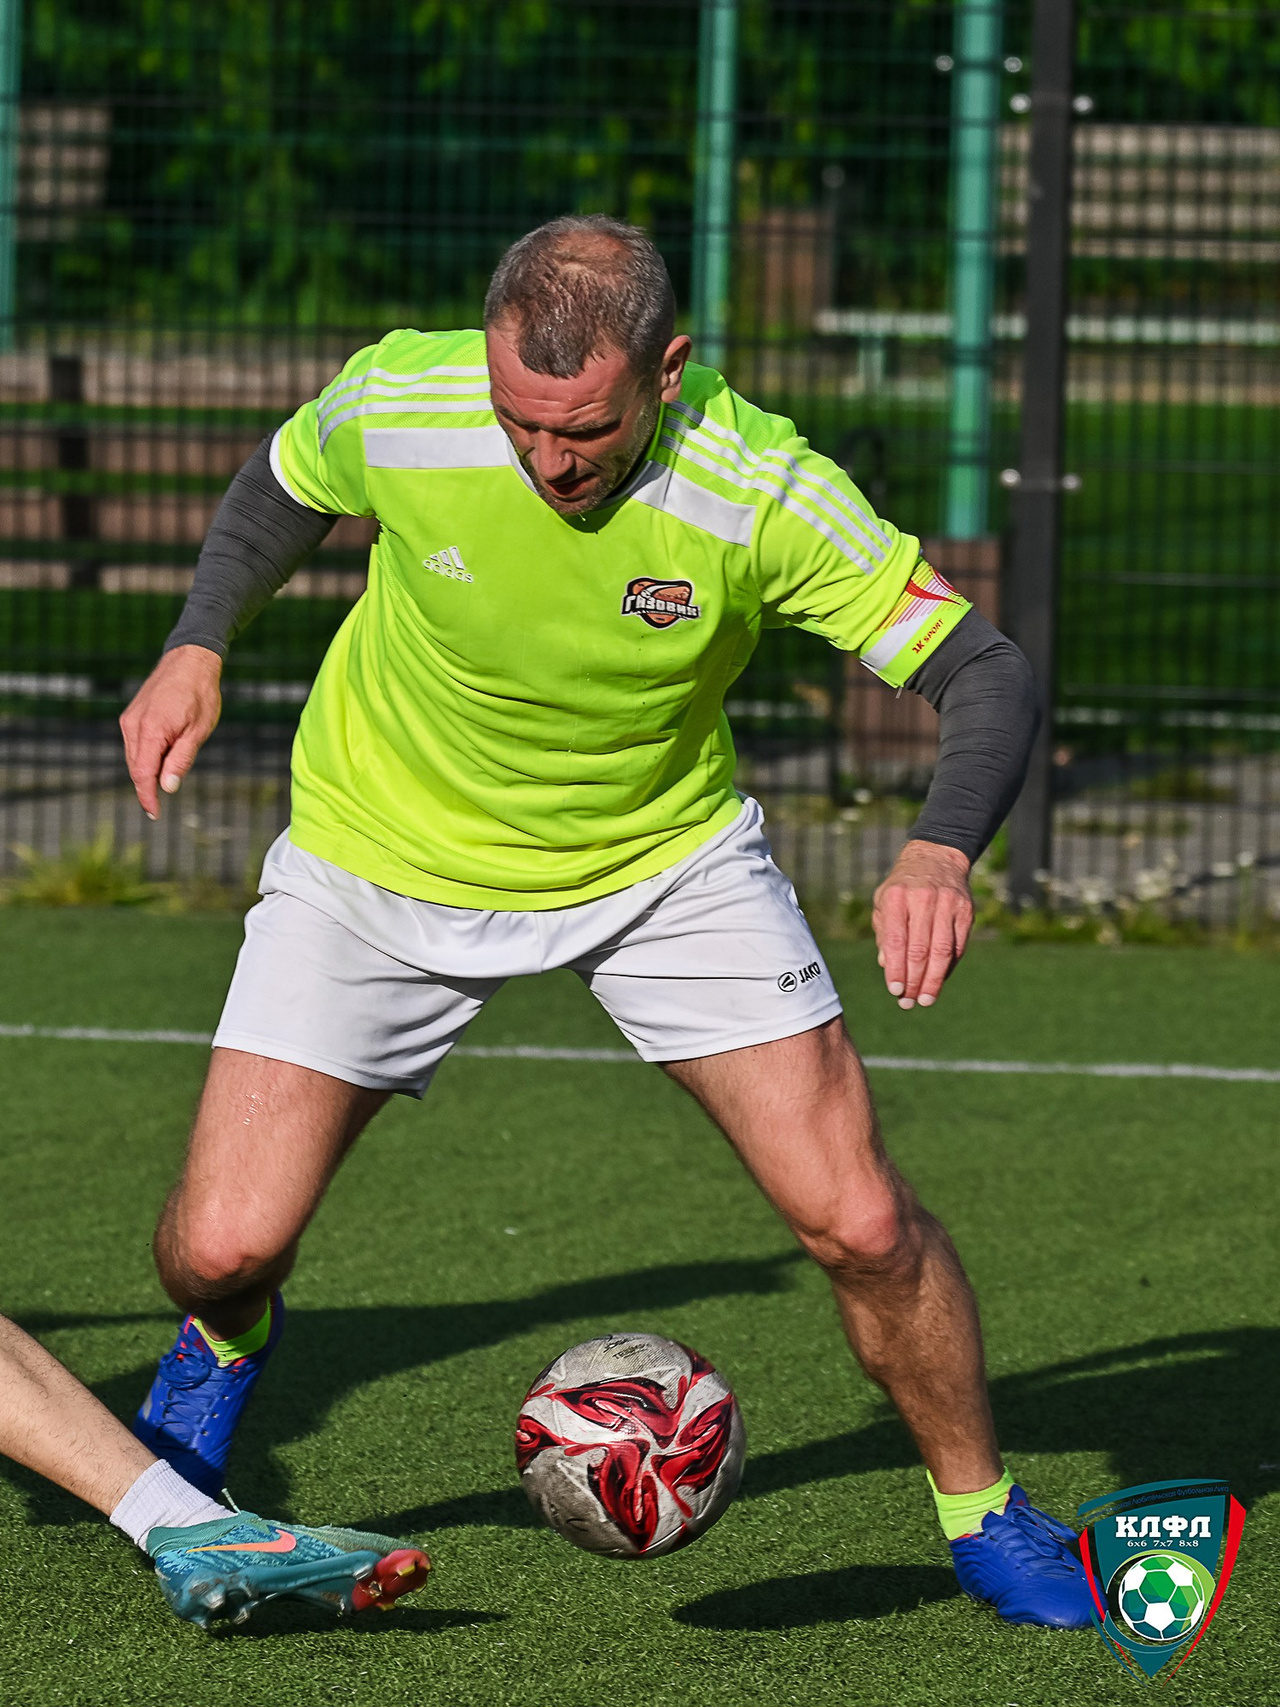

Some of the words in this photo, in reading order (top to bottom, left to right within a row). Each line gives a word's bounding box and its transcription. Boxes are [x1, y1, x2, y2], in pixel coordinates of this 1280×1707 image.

[423, 559, 474, 584] adidas
[924, 618, 944, 642] SPORT
[798, 961, 821, 984] JAKO
